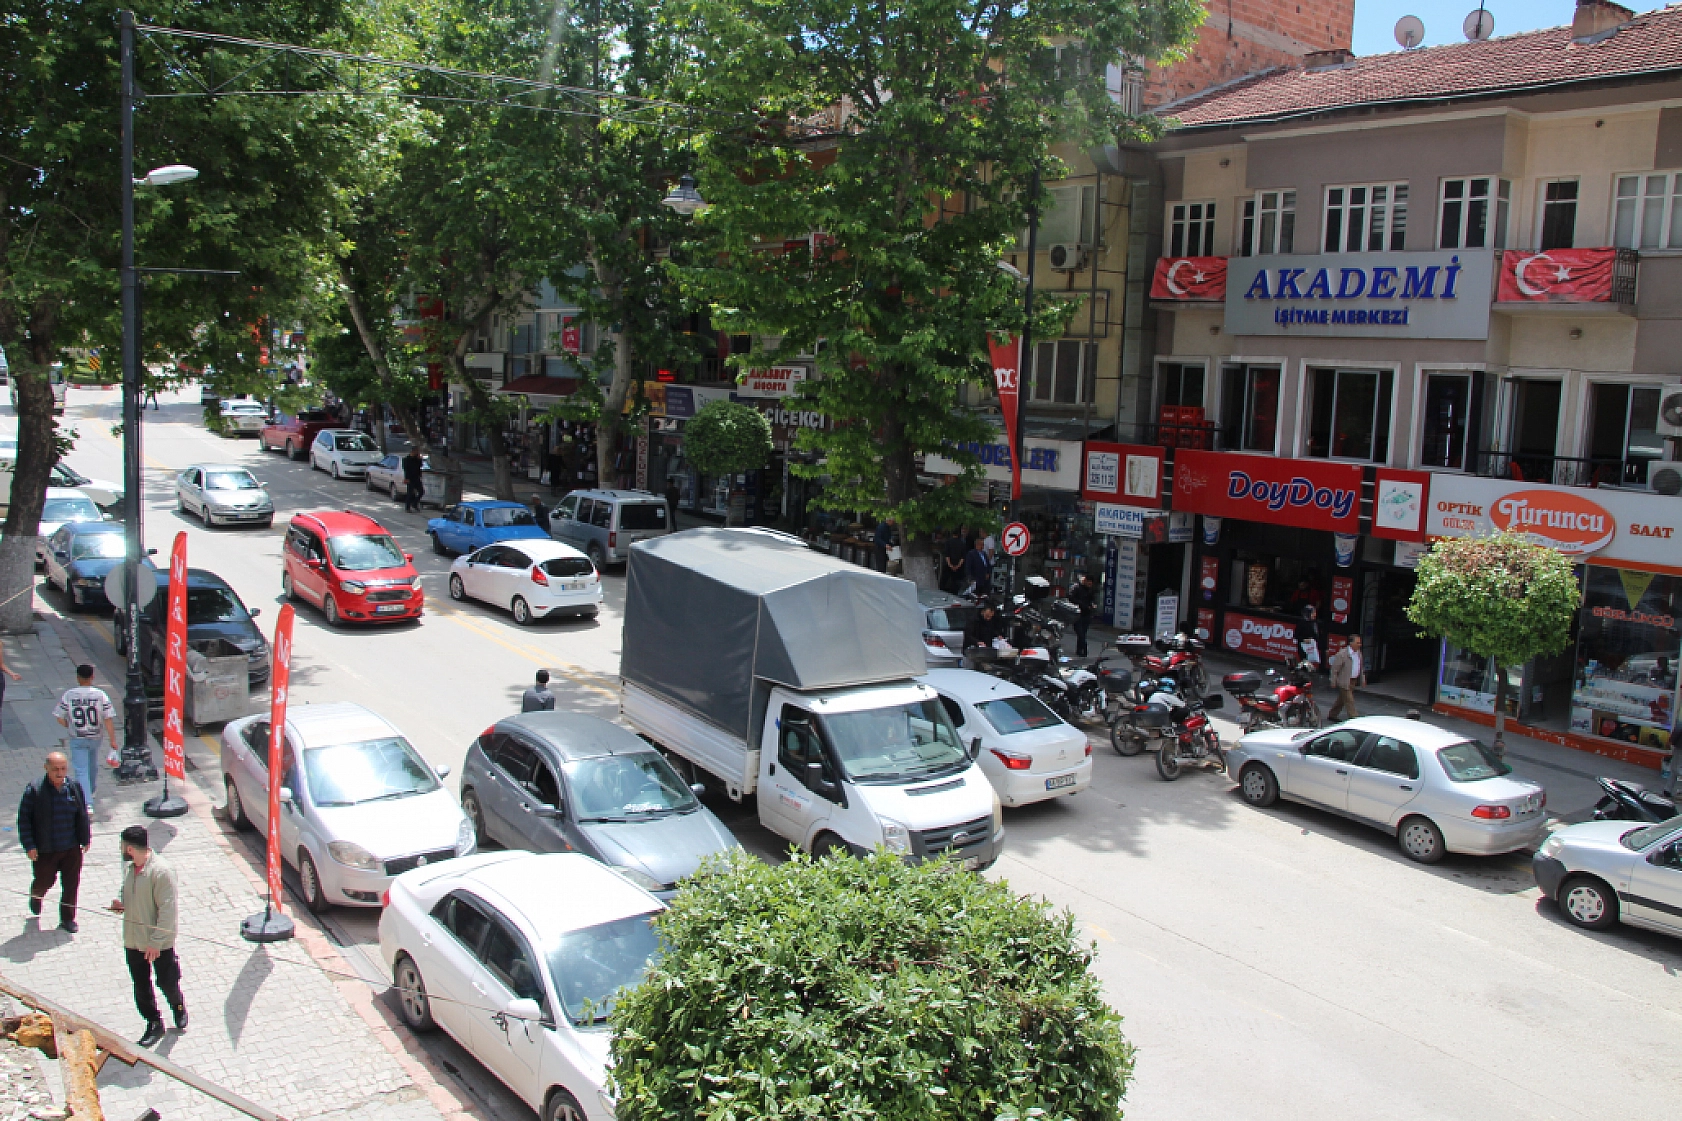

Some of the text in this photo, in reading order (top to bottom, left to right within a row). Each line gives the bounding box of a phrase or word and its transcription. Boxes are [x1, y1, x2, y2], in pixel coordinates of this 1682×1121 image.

[1243, 255, 1462, 301] AKADEMİ
[1274, 305, 1410, 328] İŞİTME MERKEZİ
[765, 404, 825, 431] ÇİÇEKÇİ
[1227, 471, 1356, 518] DoyDoy
[1437, 499, 1674, 539] OPTİK Turuncu SAAT
[1242, 619, 1298, 644] DoyDo
[73, 707, 98, 728] 90
